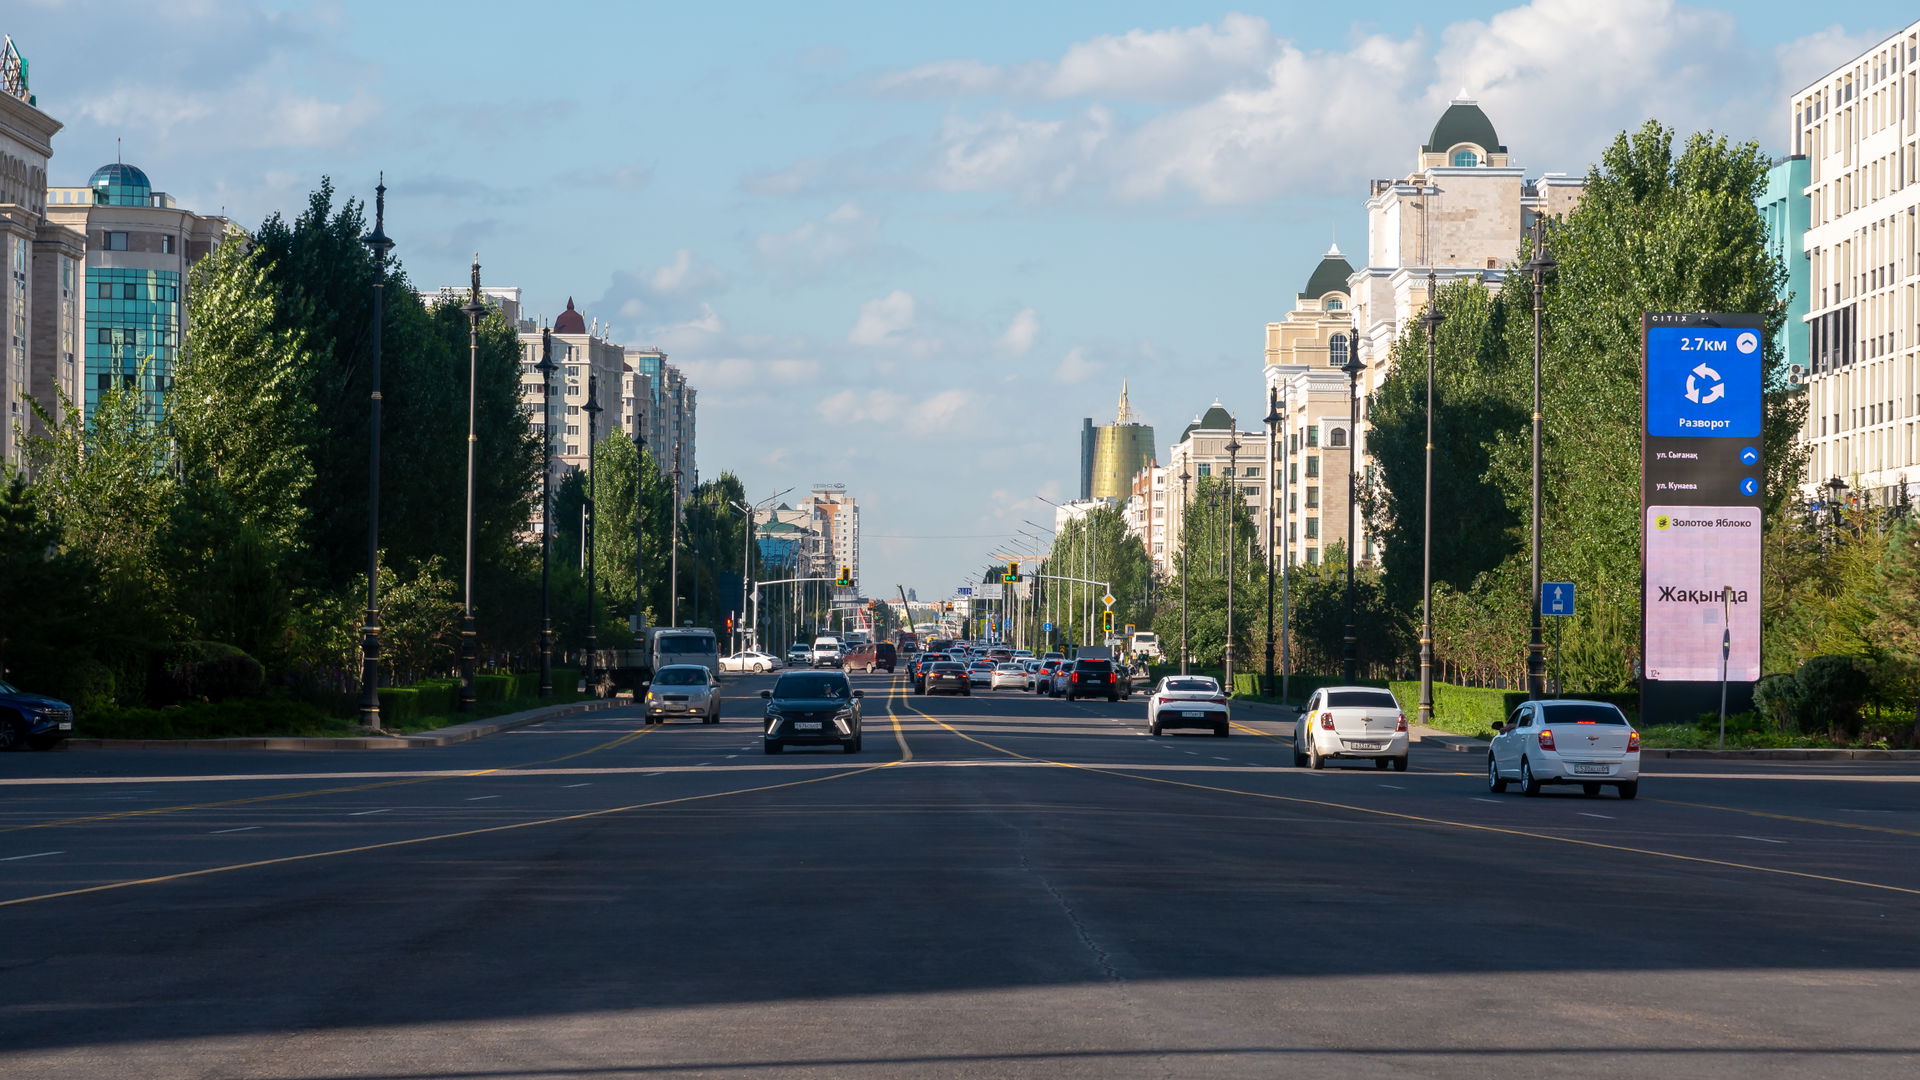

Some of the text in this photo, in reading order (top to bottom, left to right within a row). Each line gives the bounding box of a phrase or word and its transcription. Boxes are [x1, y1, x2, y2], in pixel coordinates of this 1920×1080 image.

[1679, 417, 1730, 430] Разворот
[1656, 452, 1667, 460] ул.
[1668, 482, 1697, 490] Кунаева
[1672, 518, 1752, 528] Золотое Яблоко
